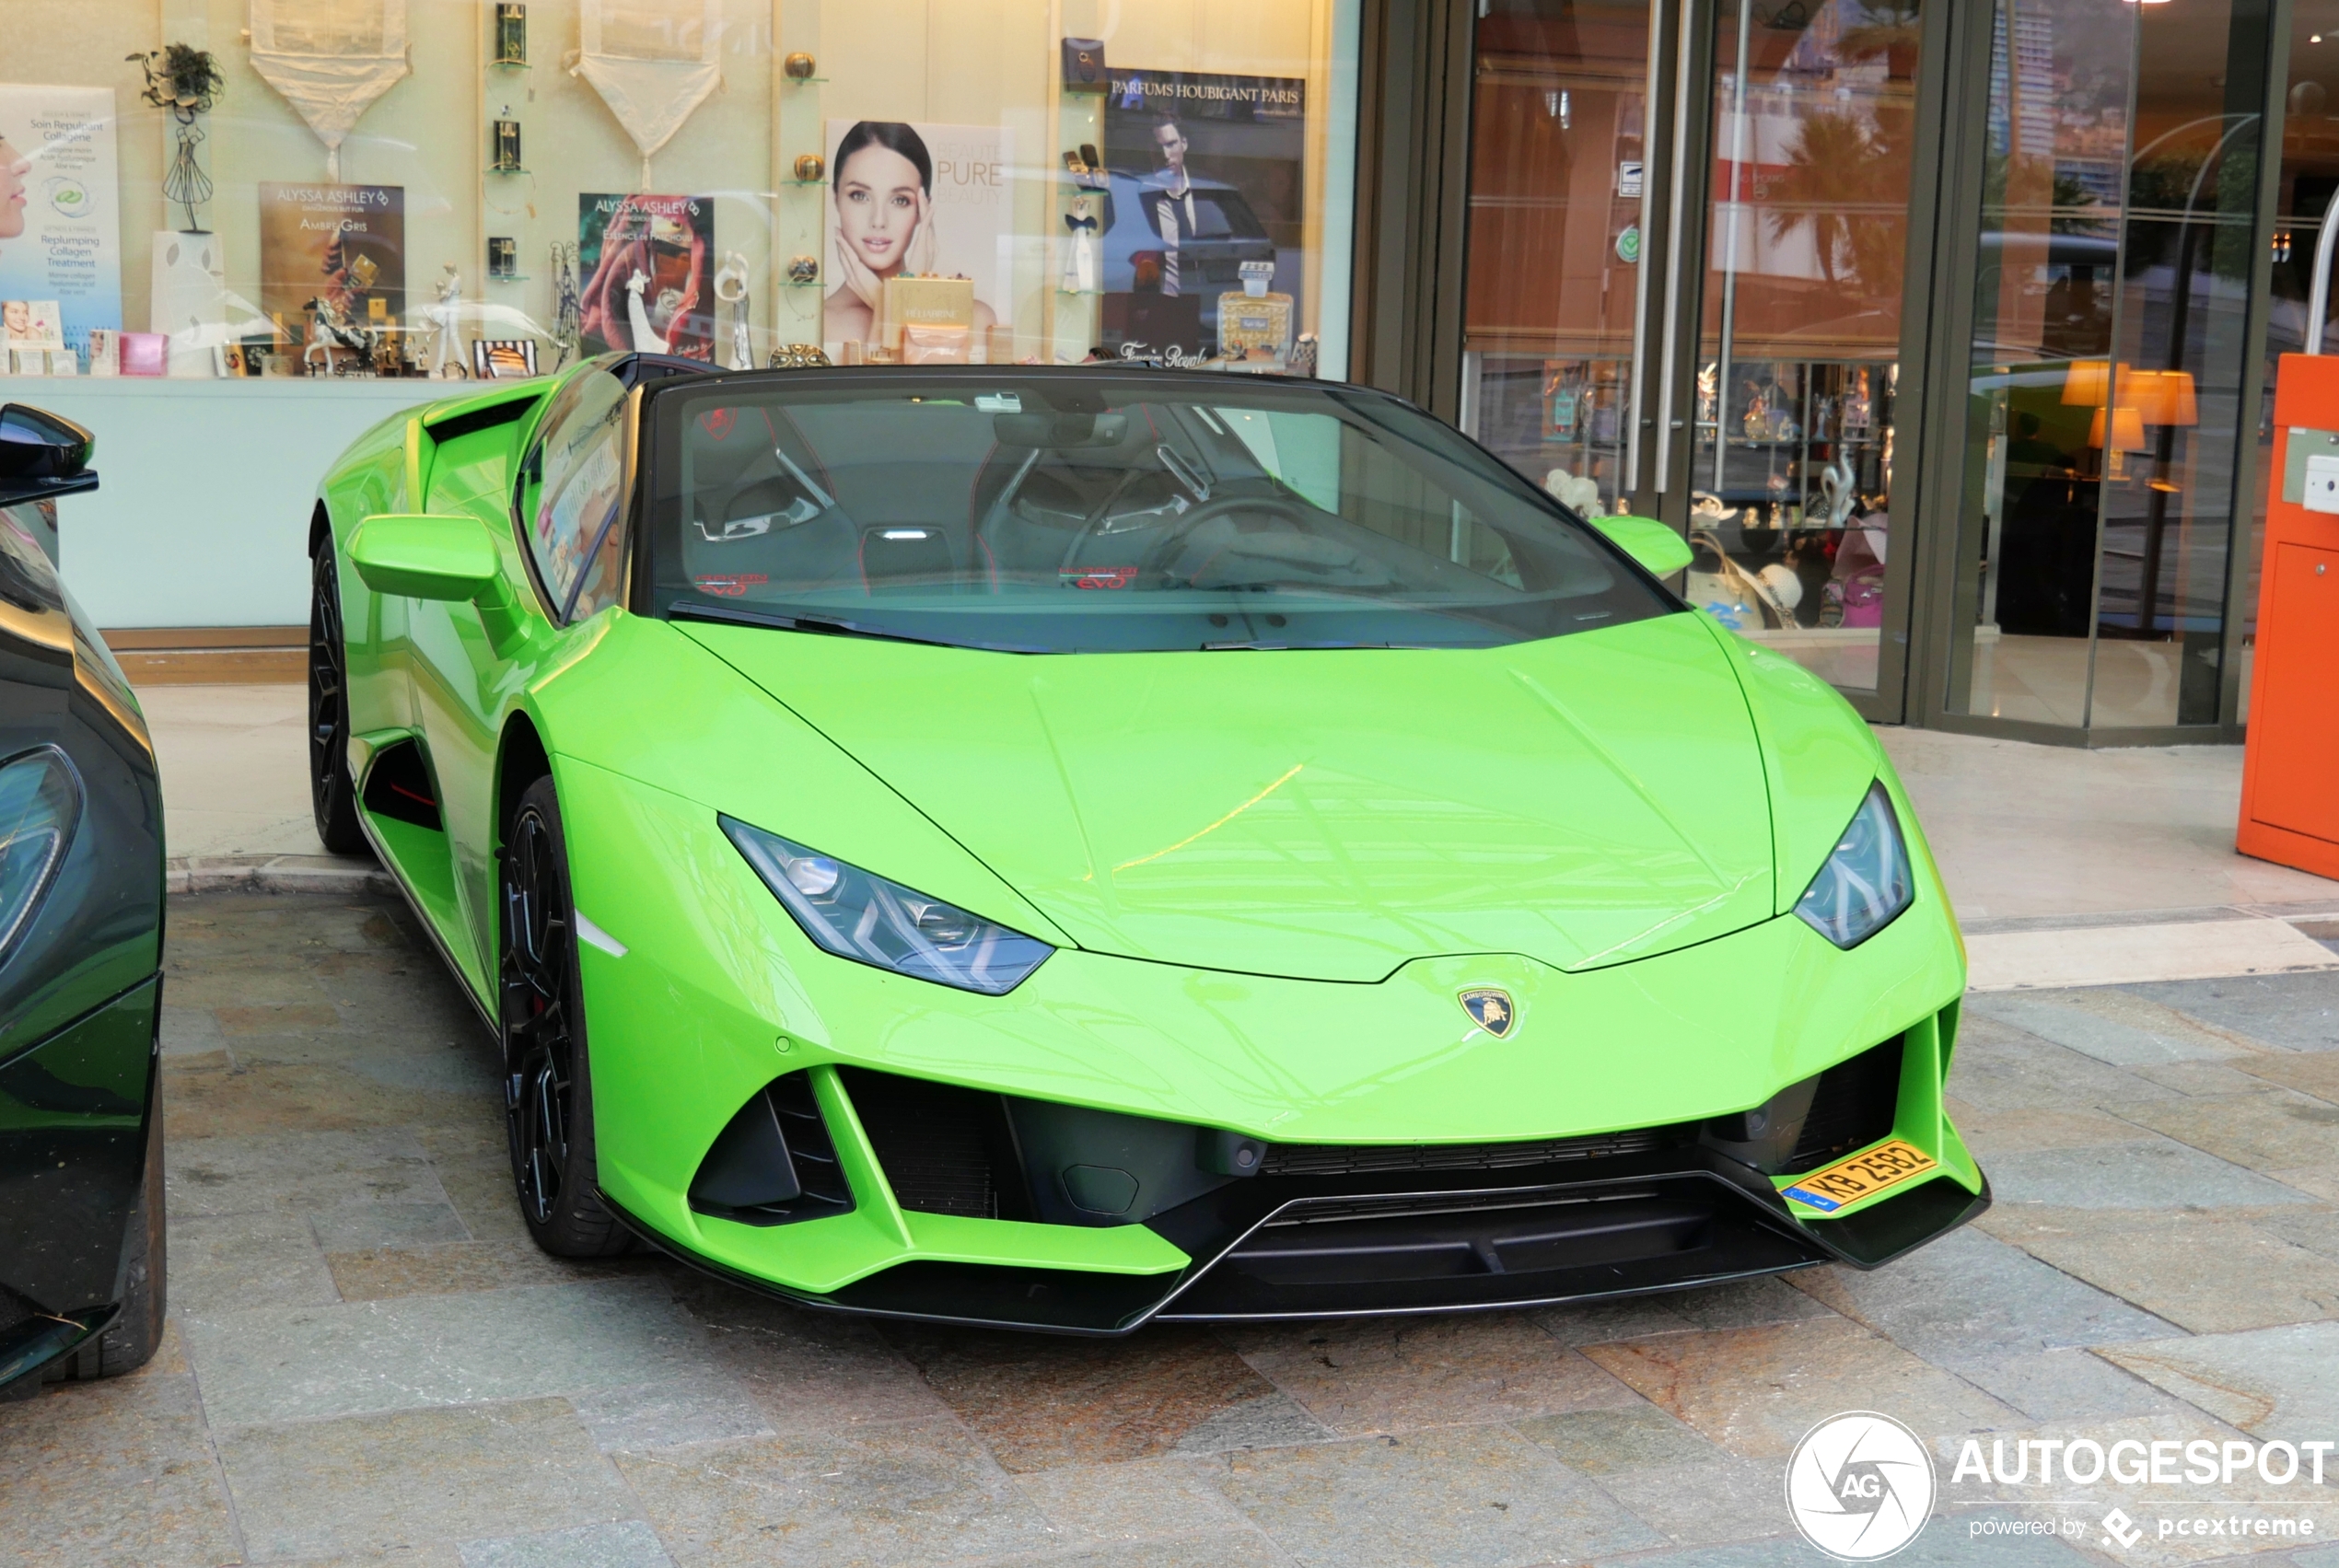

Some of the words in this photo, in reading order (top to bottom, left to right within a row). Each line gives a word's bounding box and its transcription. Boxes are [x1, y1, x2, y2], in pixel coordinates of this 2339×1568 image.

[1111, 80, 1173, 97] PARFUMS
[1176, 85, 1258, 101] HOUBIGANT
[1262, 89, 1299, 104] PARIS
[30, 119, 52, 129] Soin
[53, 120, 103, 132] Repulpant
[43, 131, 91, 144] Collagène
[937, 160, 1004, 187] PURE
[277, 189, 323, 203] ALYSSA
[327, 190, 376, 204] ASHLEY
[937, 187, 1002, 204] BEAUTY
[595, 200, 639, 213] ALYSSA
[642, 201, 687, 215] ASHLEY
[41, 235, 99, 248] Replumping
[50, 247, 91, 258] Collagen
[47, 258, 96, 268] Treatment
[1077, 576, 1126, 590] EVO
[1807, 1174, 1868, 1199] KB
[1846, 1147, 1932, 1182] 2582
